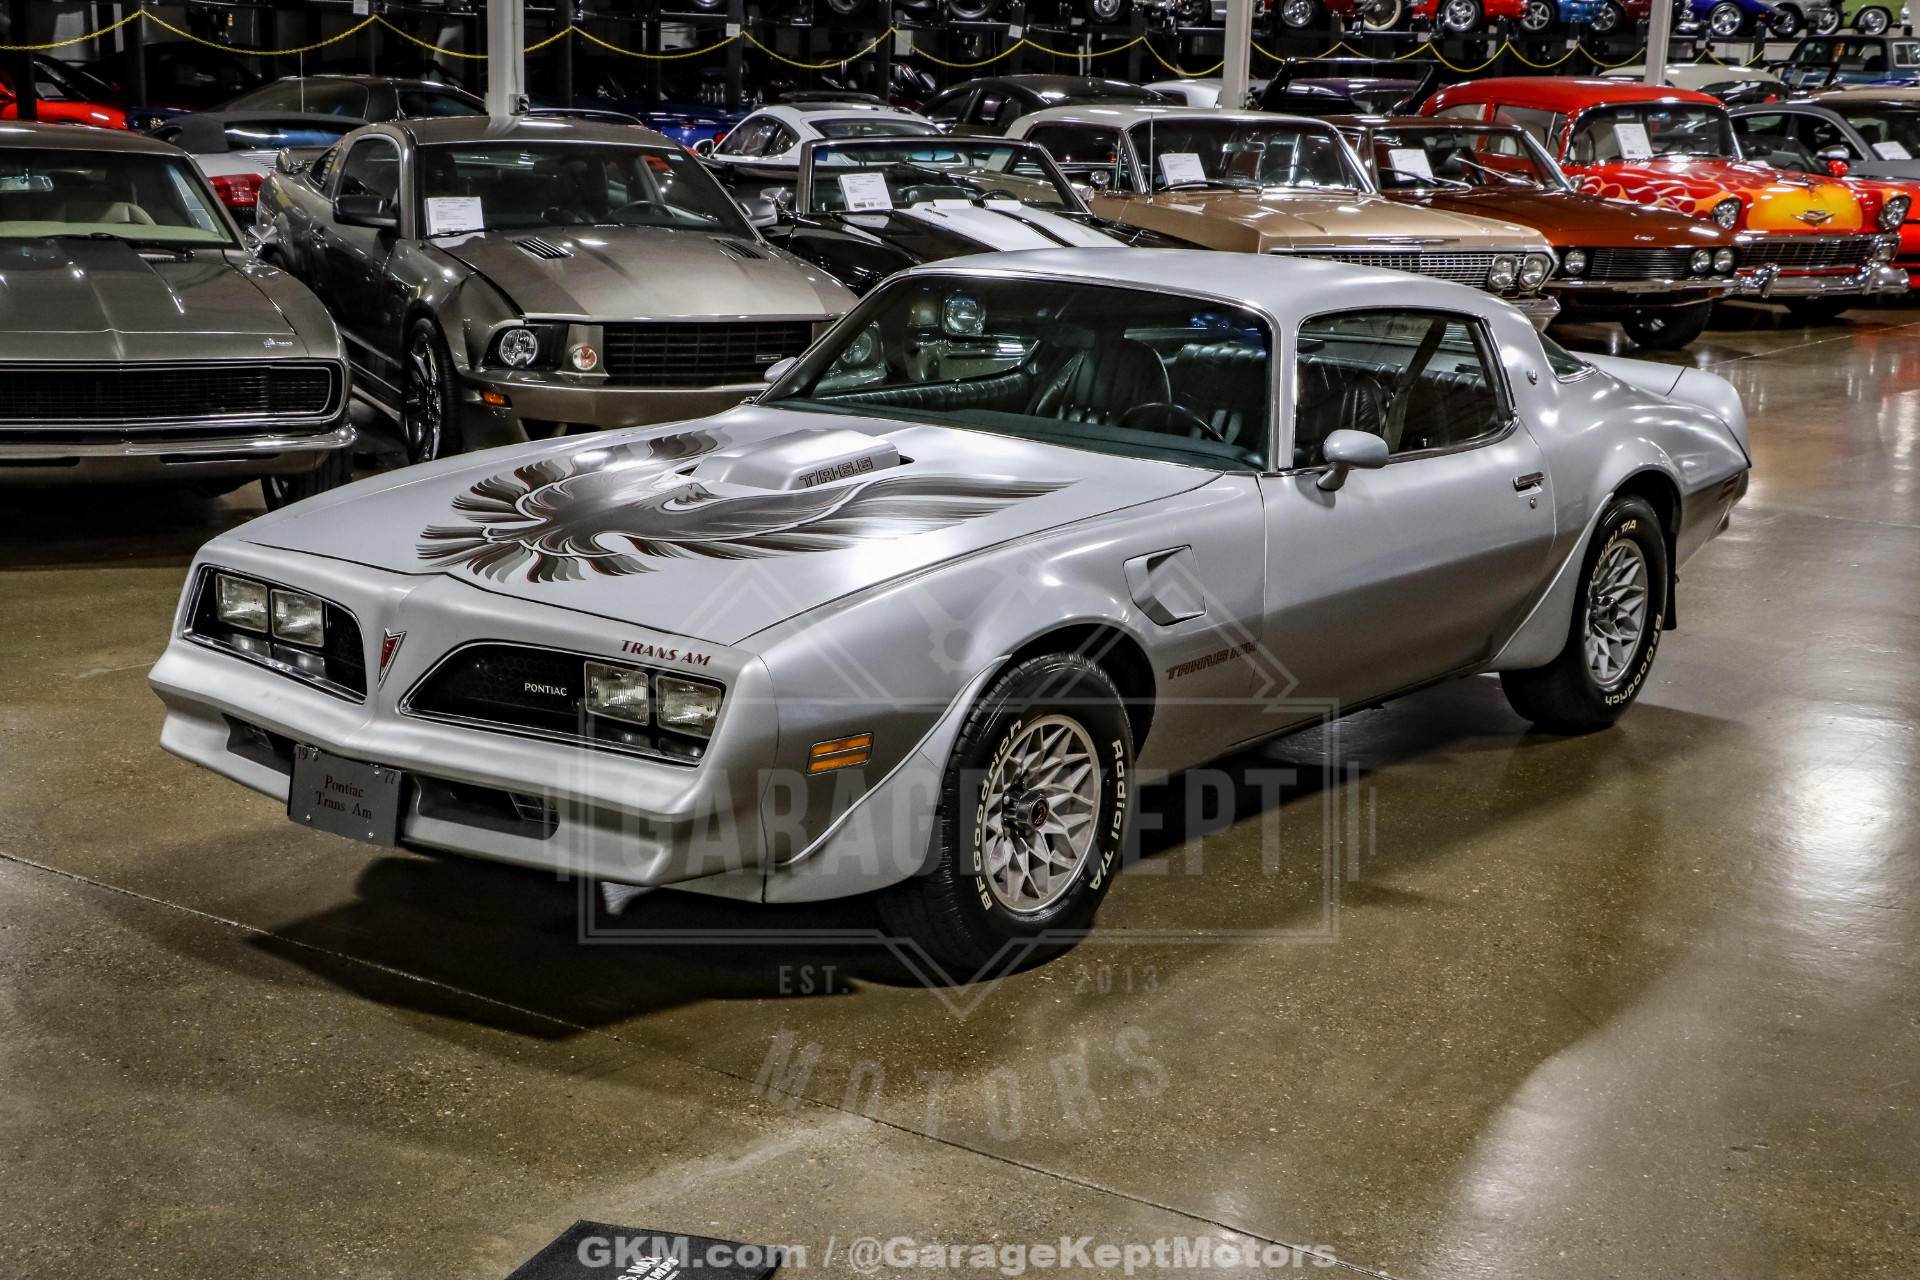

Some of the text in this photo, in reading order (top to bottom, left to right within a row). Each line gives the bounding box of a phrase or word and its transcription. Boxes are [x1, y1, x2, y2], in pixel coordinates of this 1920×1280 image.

[621, 639, 712, 667] TRANS AM
[1166, 648, 1230, 681] TRANS
[524, 682, 567, 697] PONTIAC
[324, 774, 364, 798] Pontiac
[384, 769, 396, 785] 77
[315, 790, 373, 820] Trans Am
[973, 719, 1022, 910] BFGoodrich
[1089, 739, 1126, 890] Radial T/A
